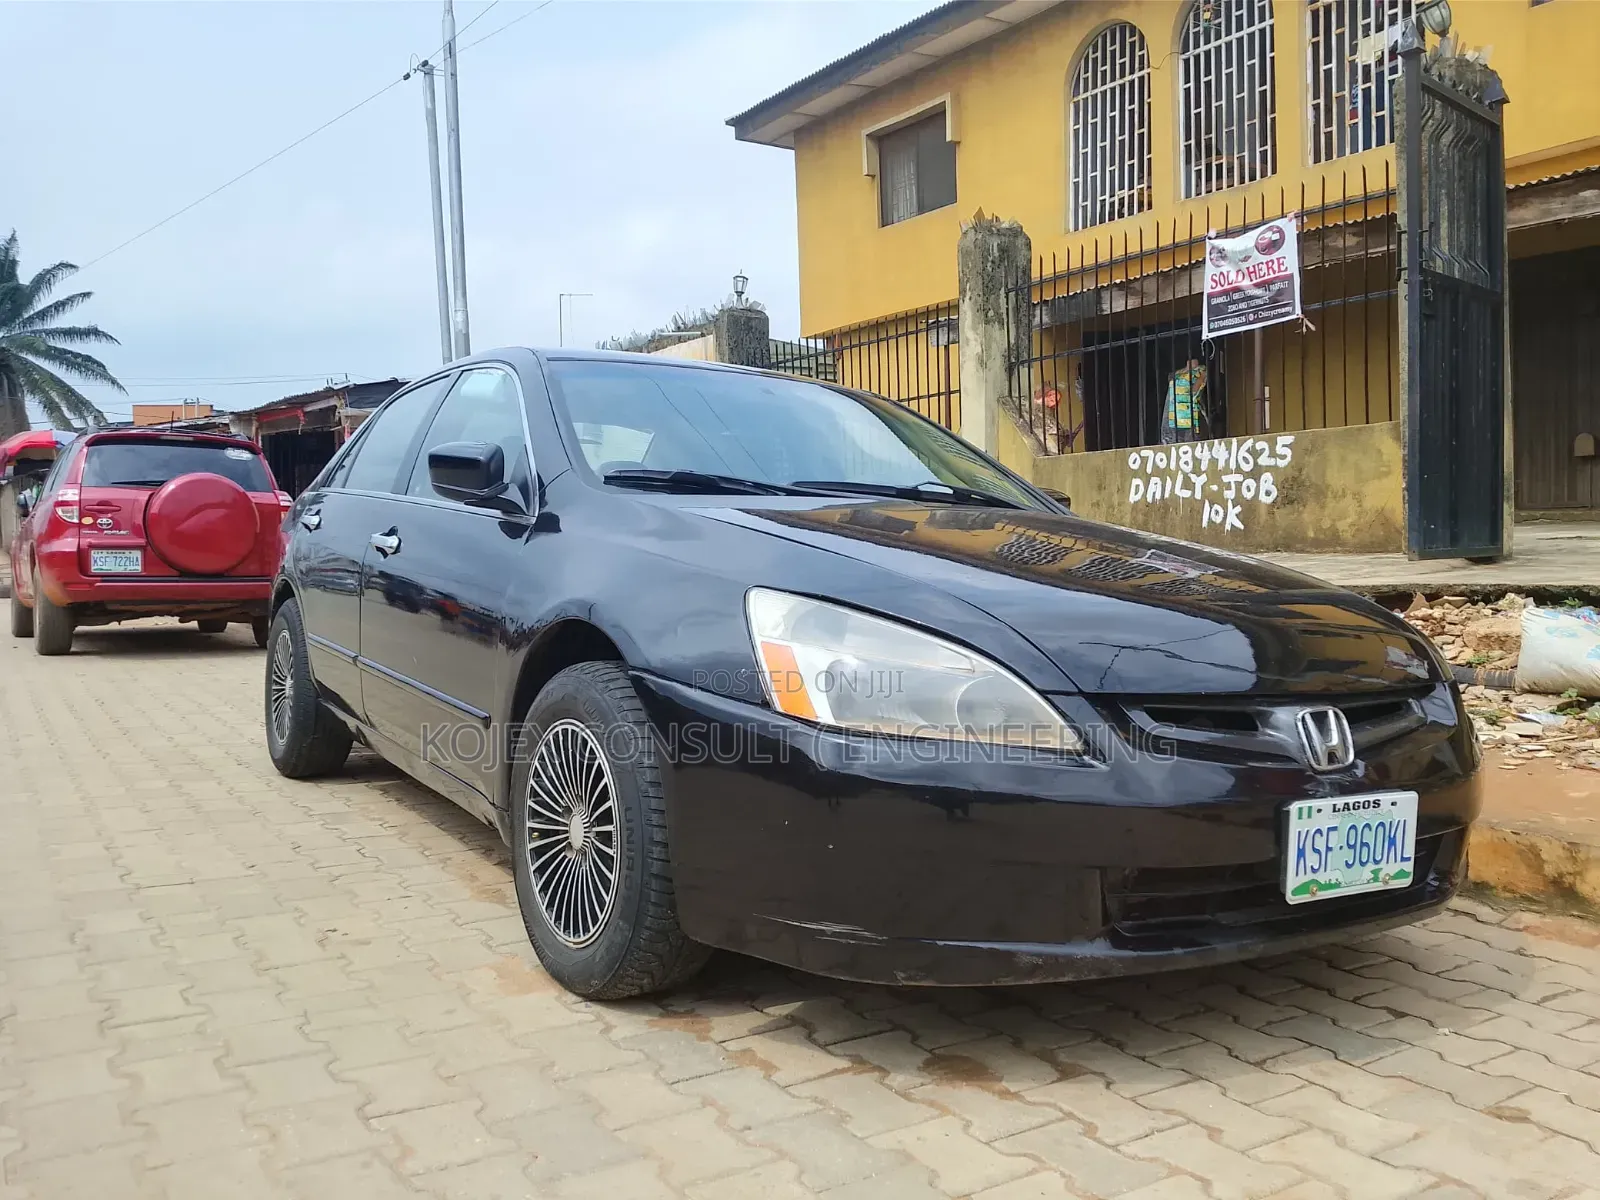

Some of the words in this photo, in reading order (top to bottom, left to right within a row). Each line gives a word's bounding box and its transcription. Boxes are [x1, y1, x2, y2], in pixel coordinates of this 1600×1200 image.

[1210, 269, 1245, 290] SOLD
[1246, 256, 1288, 282] HERE
[1128, 435, 1295, 474] 07018441625
[1332, 799, 1381, 813] LAGOS
